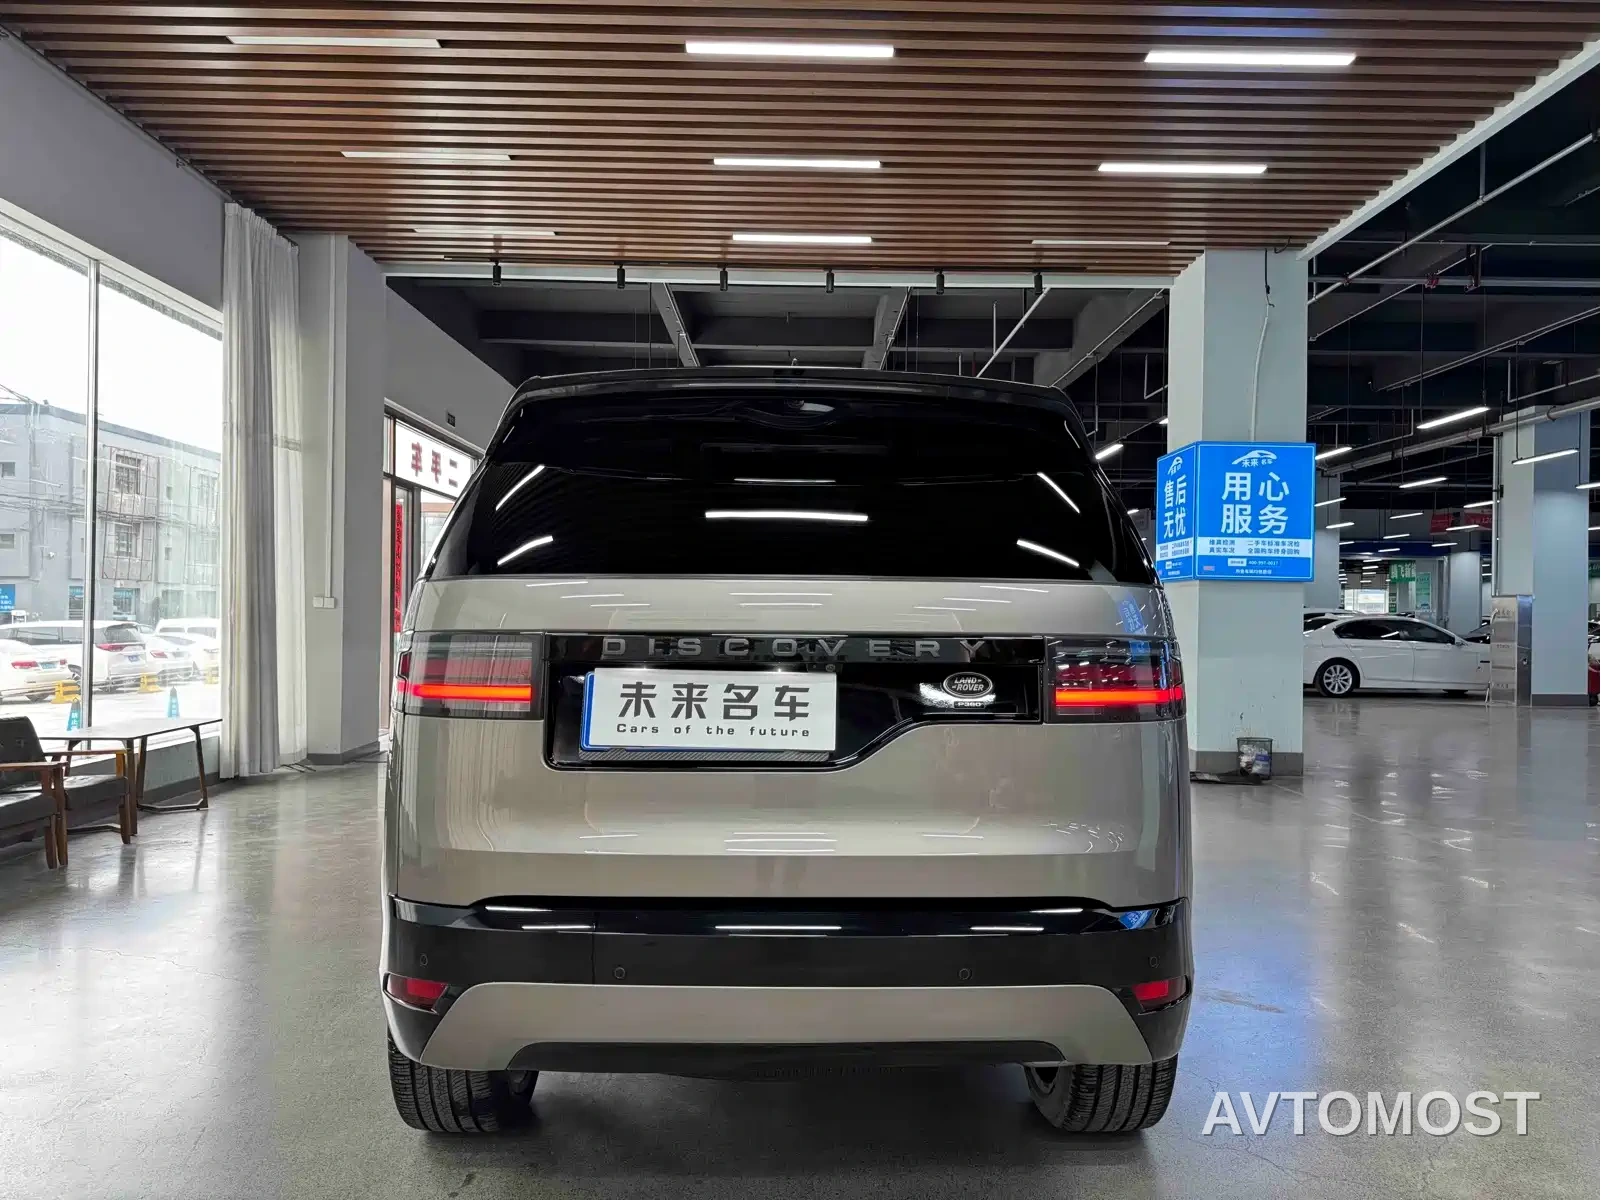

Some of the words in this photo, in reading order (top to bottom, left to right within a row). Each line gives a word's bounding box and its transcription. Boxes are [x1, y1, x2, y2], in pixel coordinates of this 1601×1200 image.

[1164, 474, 1187, 509] 售后
[1221, 472, 1290, 501] 用心
[1163, 506, 1187, 539] 无忧
[1220, 504, 1289, 535] 服务
[602, 639, 985, 659] DISCOVERY
[618, 682, 810, 721] 未来名车
[616, 723, 659, 734] Cars
[673, 724, 692, 734] of
[706, 725, 735, 736] the
[750, 726, 810, 737] future
